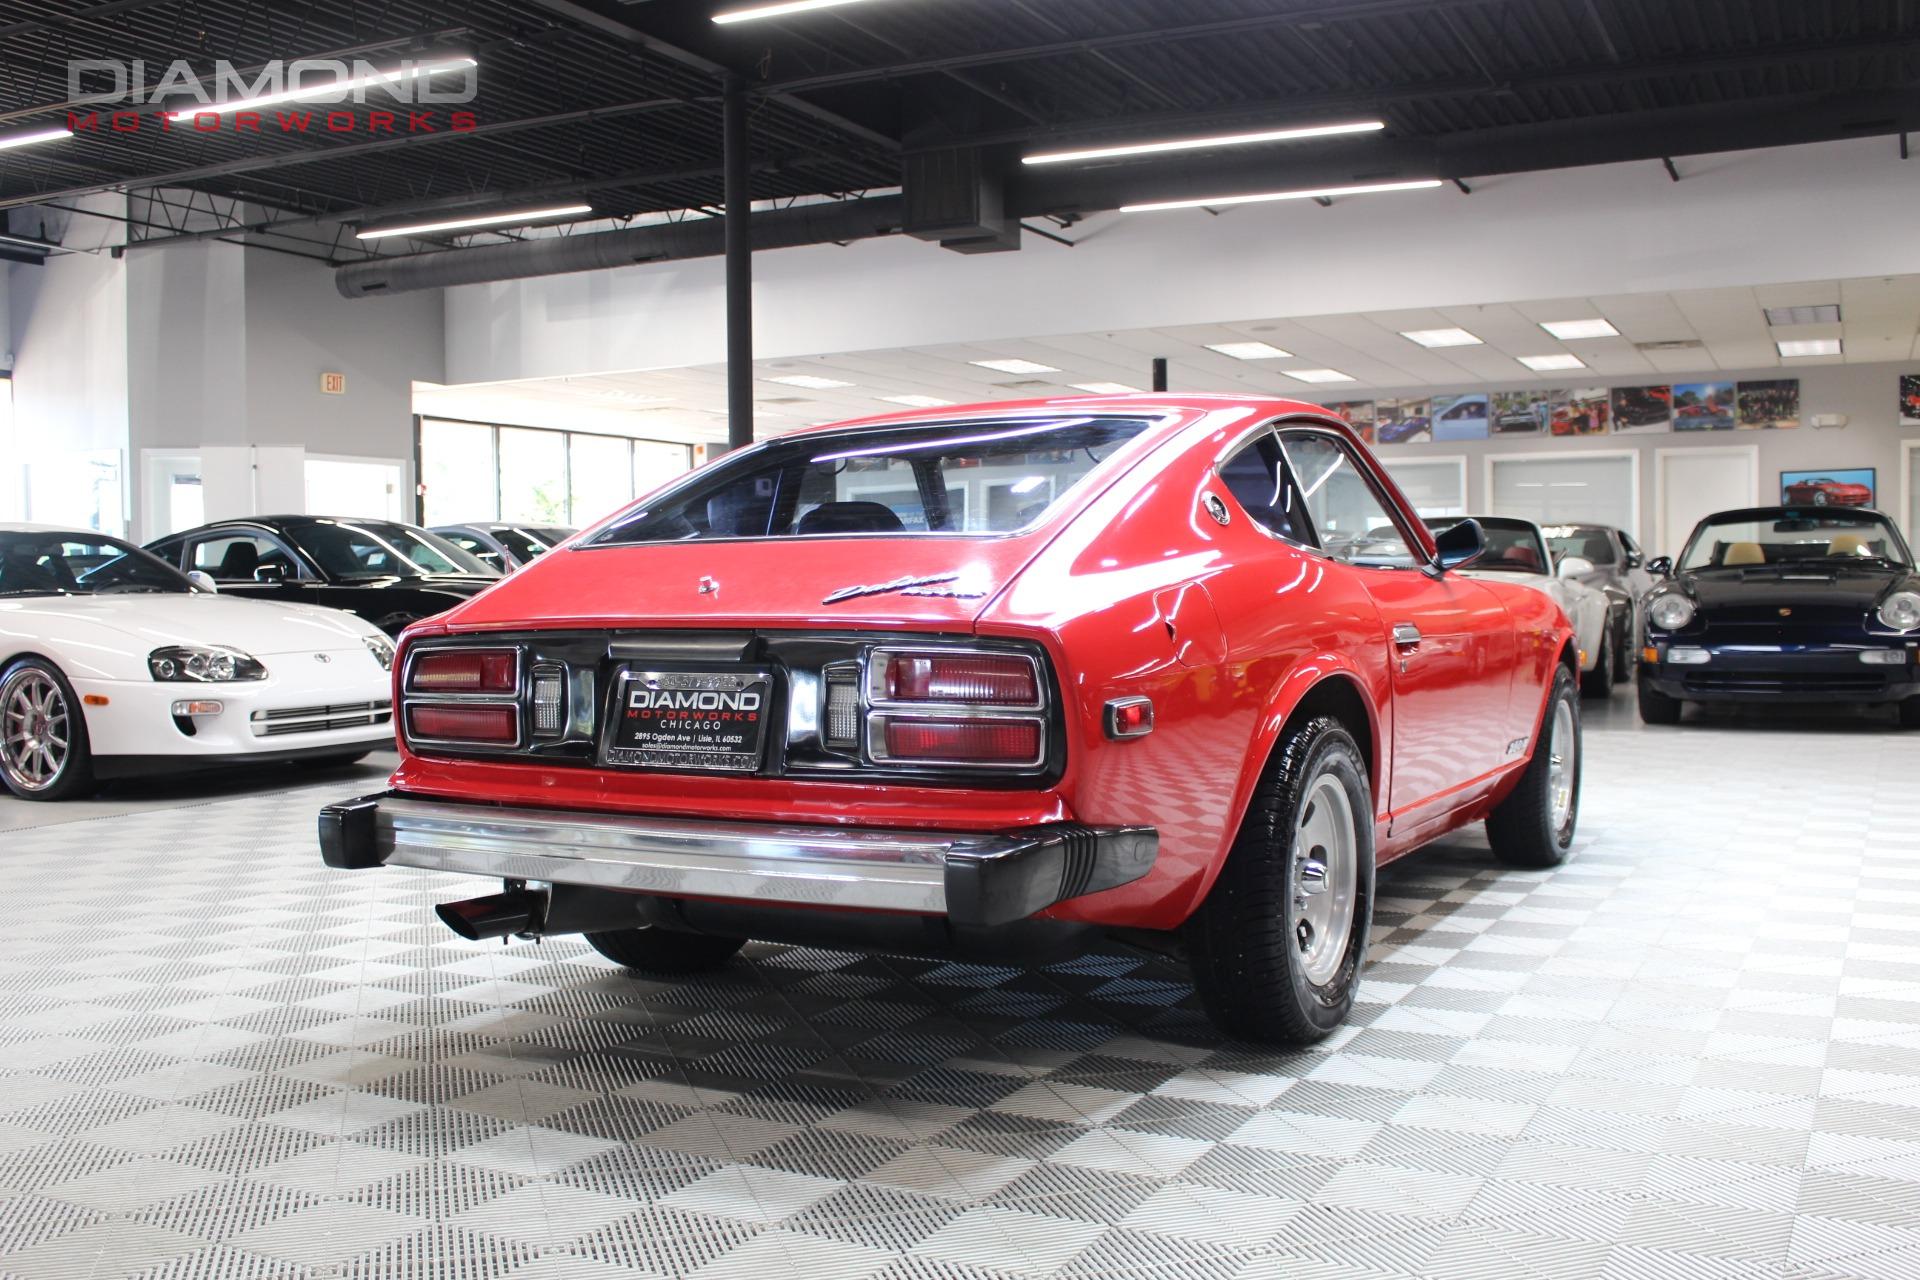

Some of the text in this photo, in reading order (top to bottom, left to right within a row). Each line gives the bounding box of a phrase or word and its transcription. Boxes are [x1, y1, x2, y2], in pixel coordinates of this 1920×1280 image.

[326, 374, 343, 392] EXIT
[630, 691, 760, 710] DIAMOND
[627, 710, 758, 722] MOTORWORKS
[660, 720, 722, 730] CHICAGO
[634, 731, 651, 741] 2895
[652, 732, 676, 743] Ogden
[677, 734, 691, 742] Ave
[715, 735, 721, 743] IL
[723, 735, 743, 744] 60532
[642, 743, 732, 752] sales@diamondmotorworks.com
[608, 750, 758, 769] DIAMONDMOTORWORKS.COM
